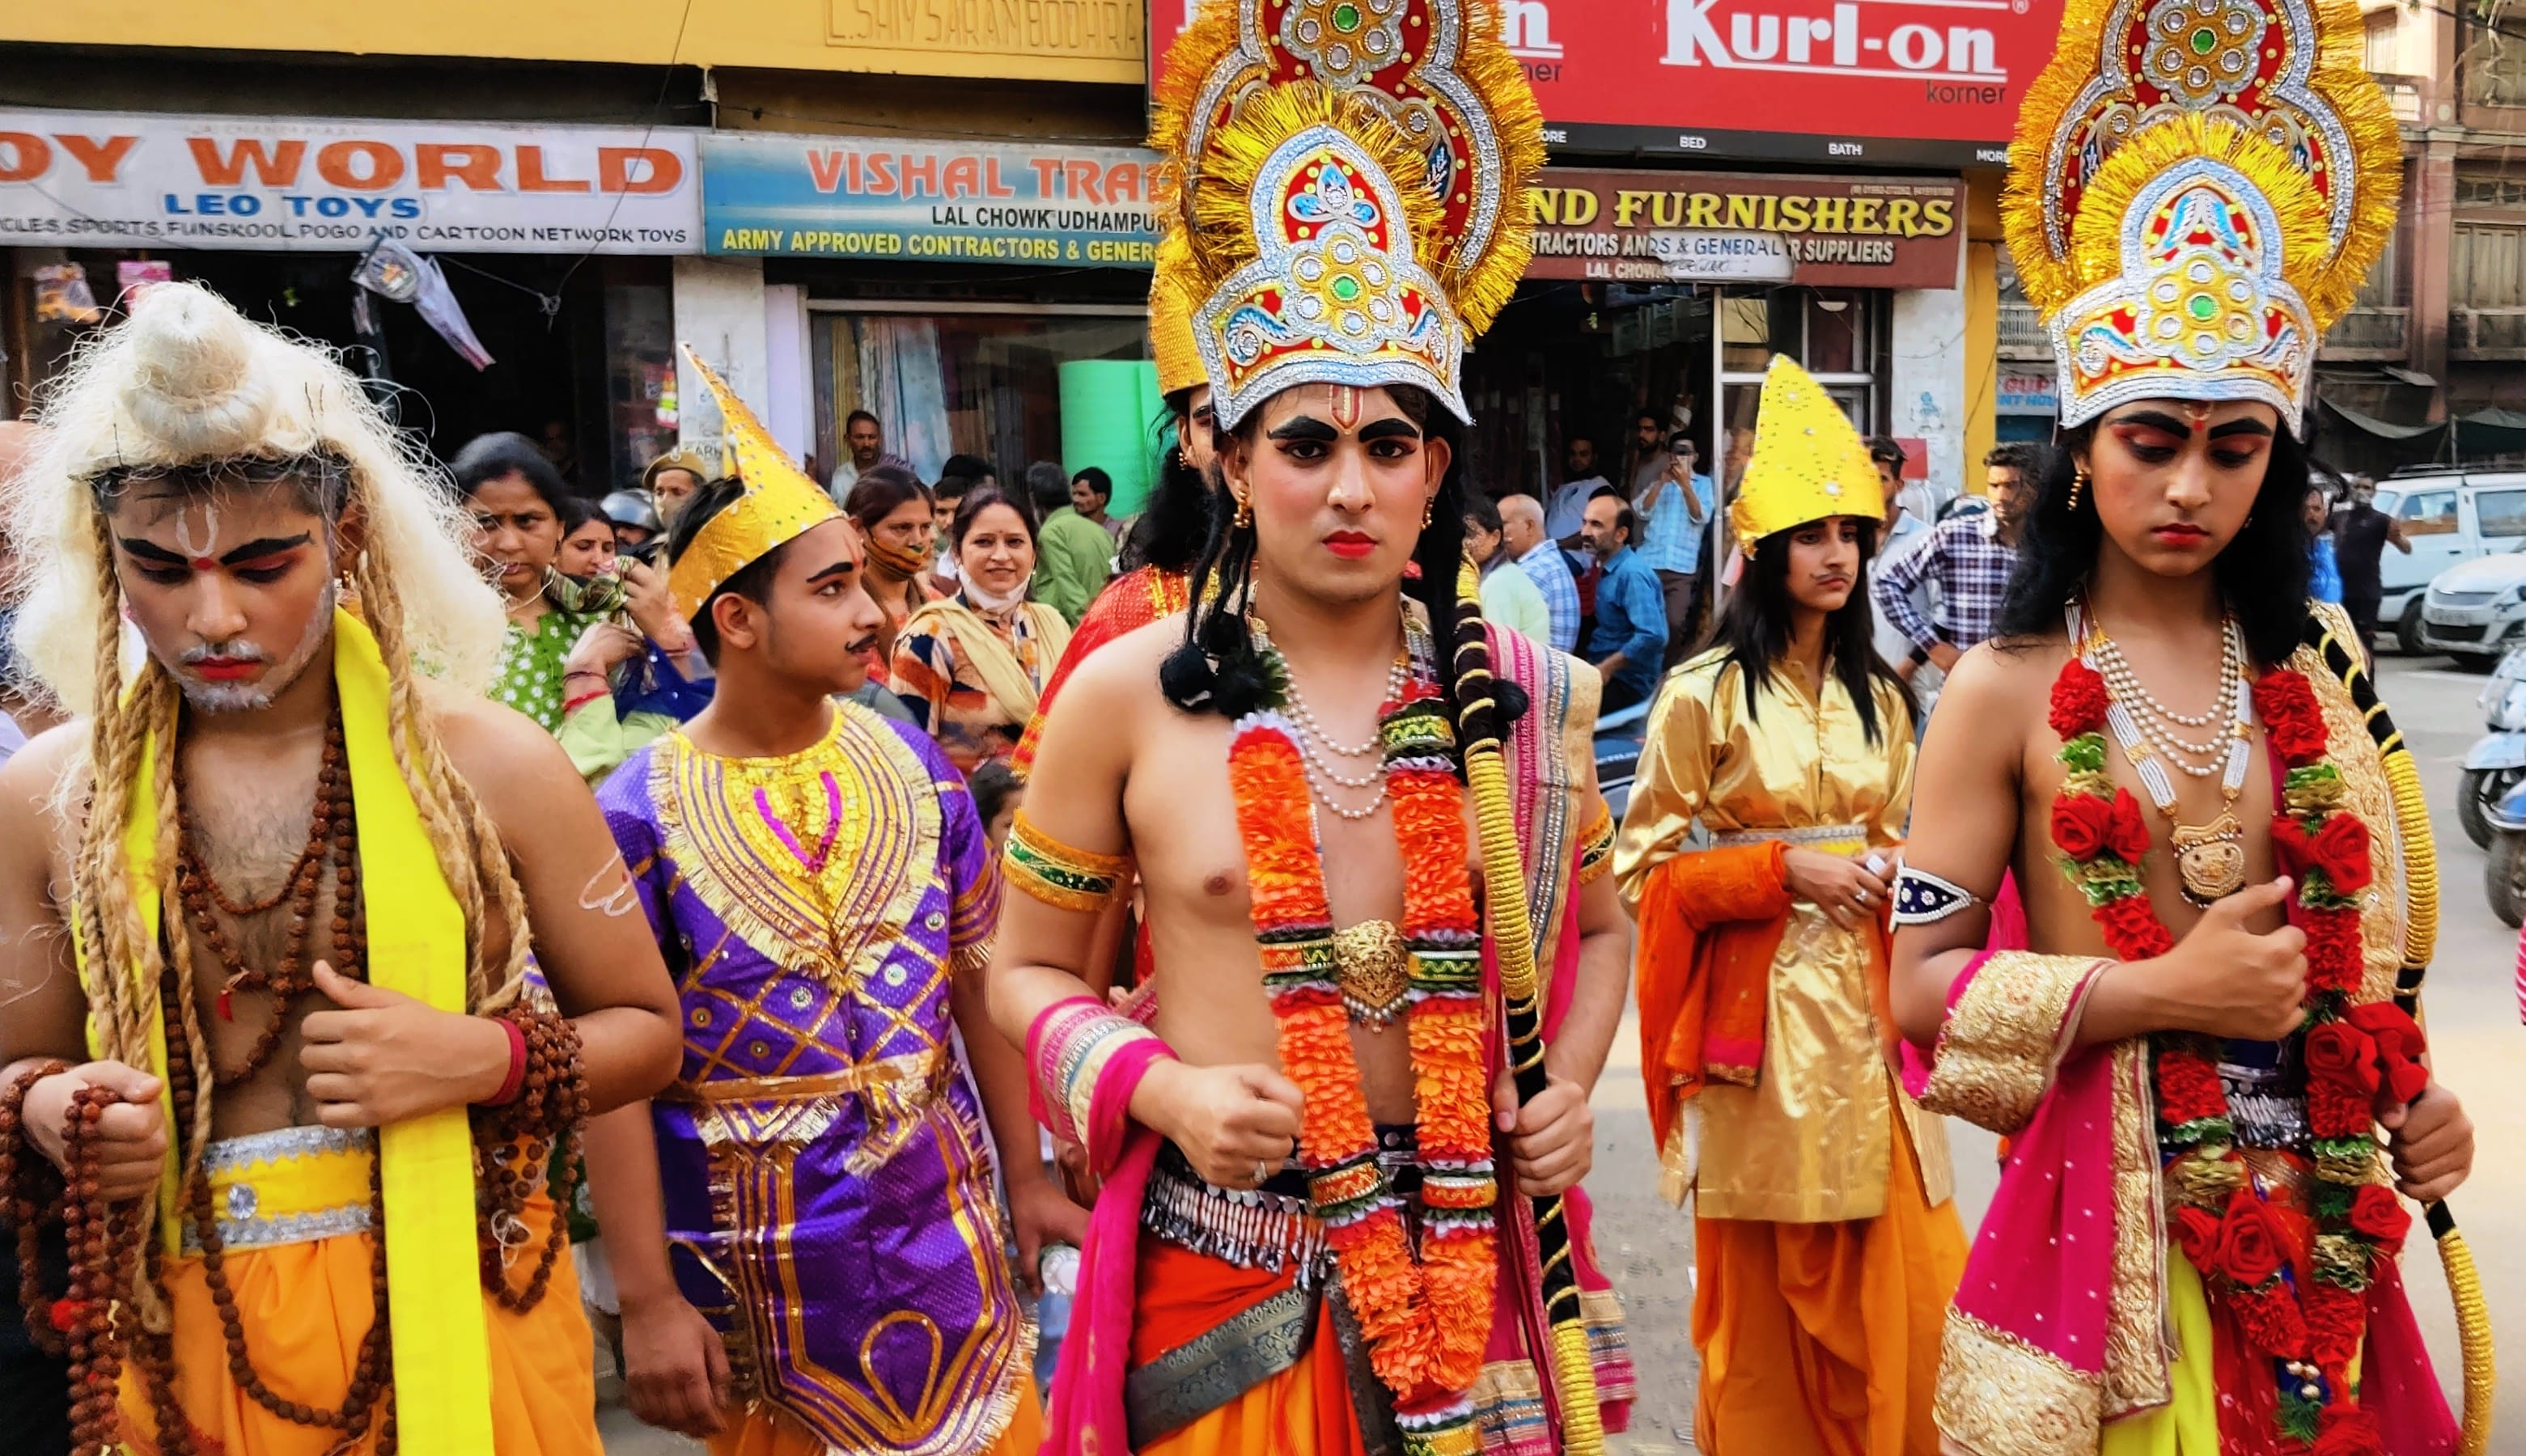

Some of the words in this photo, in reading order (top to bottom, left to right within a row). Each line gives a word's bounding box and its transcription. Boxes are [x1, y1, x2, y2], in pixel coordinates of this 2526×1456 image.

[1659, 0, 2007, 78] Kurl-on
[1926, 80, 2005, 104] korner
[1680, 136, 1706, 149] BED
[1829, 143, 1863, 156] BATH
[187, 138, 682, 193] WORLD
[807, 150, 1015, 202] VISHAL
[164, 194, 261, 216] LEO
[282, 197, 419, 219] TOYS
[932, 205, 968, 226] LAL
[976, 207, 1049, 230] CHOWK
[1525, 188, 1599, 226] ND
[1613, 190, 1954, 238] FURNISHERS
[300, 224, 360, 239] POGO
[367, 226, 408, 239] AND
[417, 226, 525, 240] CARTOON
[532, 227, 634, 243] NETWORK
[638, 229, 687, 243] TOYS
[723, 229, 783, 251] ARMY
[790, 231, 902, 255] APPROVED
[908, 235, 1060, 260] CONTRACTORS
[1066, 240, 1080, 260] &
[1087, 242, 1155, 262] GENER
[1532, 231, 1619, 256] TRACTORS
[1621, 234, 1654, 256] AN
[1695, 237, 1781, 256] GENERAL
[1804, 239, 1893, 263] SUPPLIERS
[1586, 262, 1612, 278] LAL
